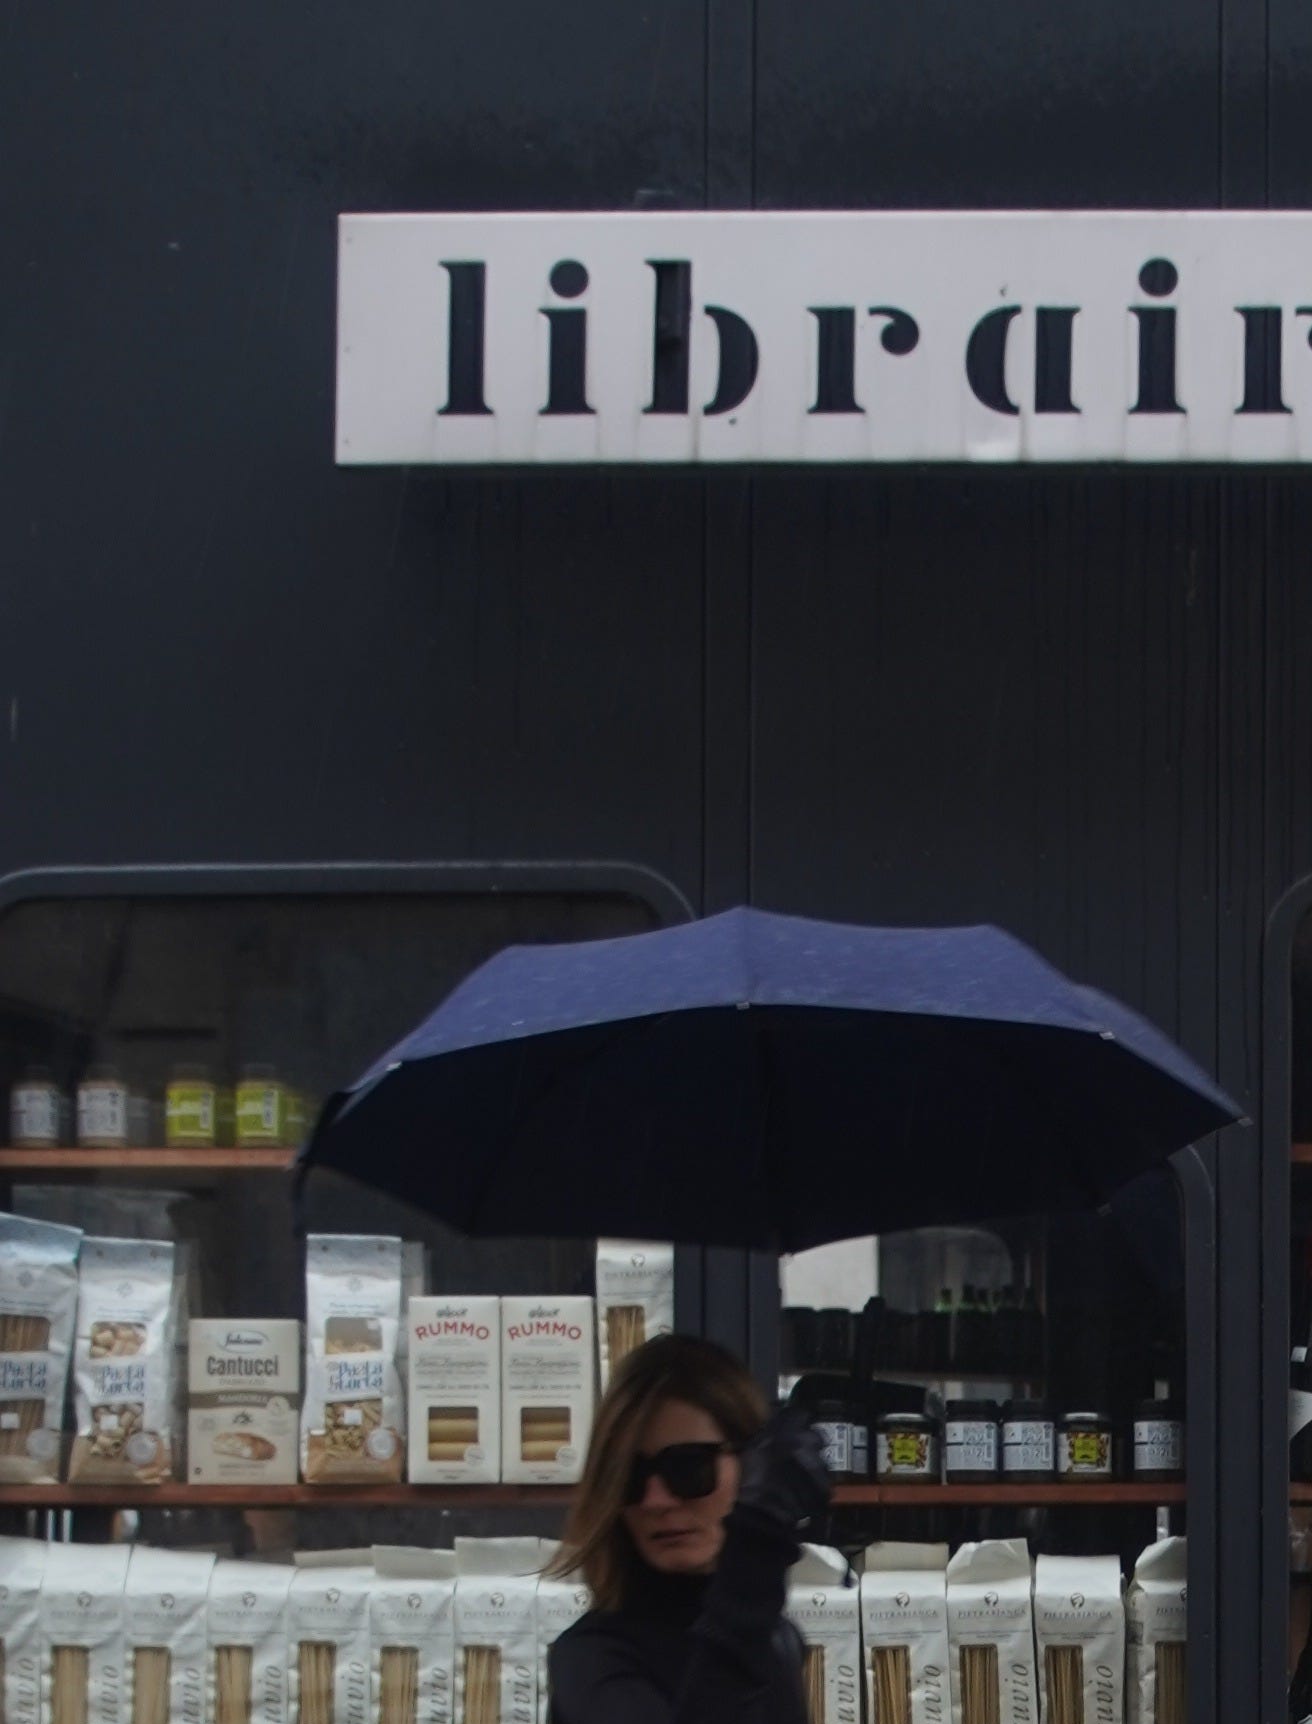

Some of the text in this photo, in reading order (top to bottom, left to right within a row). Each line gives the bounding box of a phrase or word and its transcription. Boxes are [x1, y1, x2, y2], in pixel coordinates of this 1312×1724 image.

[415, 1320, 490, 1341] RUMMO
[508, 1320, 582, 1341] RUMMO
[206, 1355, 279, 1376] Cantucci
